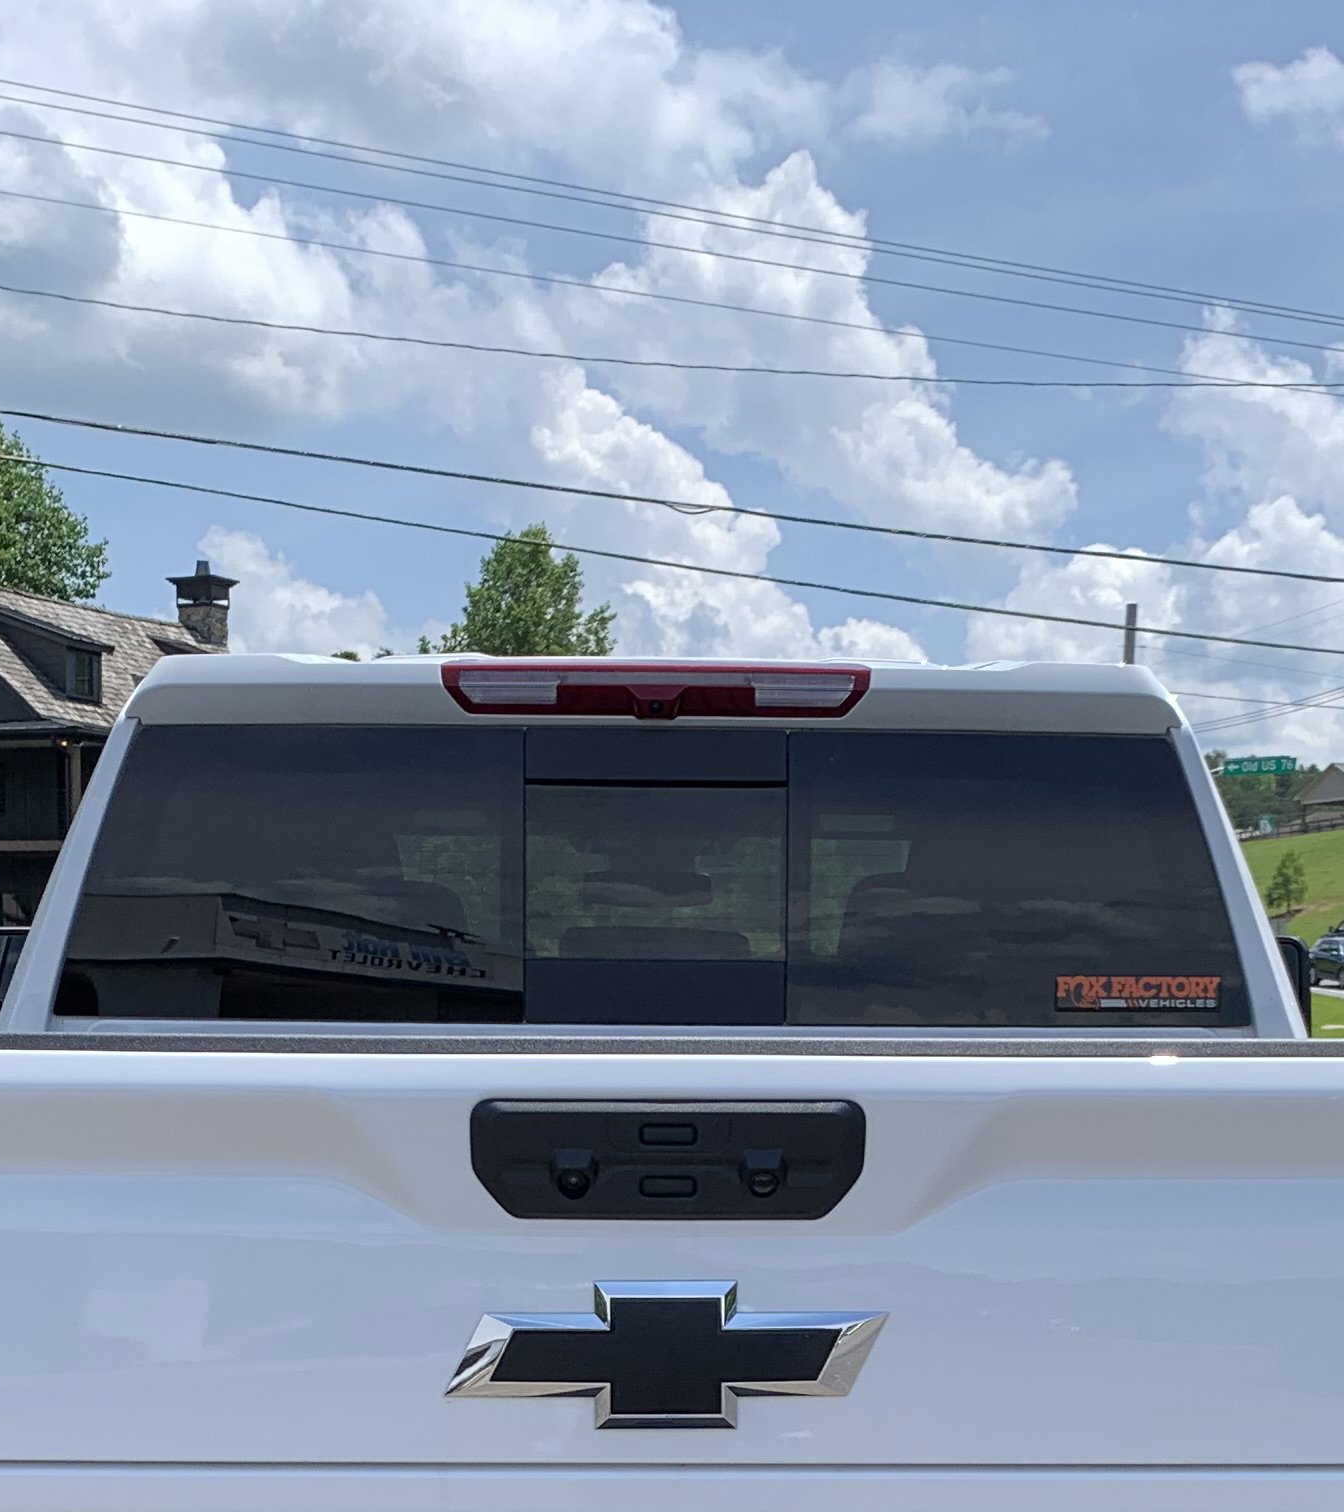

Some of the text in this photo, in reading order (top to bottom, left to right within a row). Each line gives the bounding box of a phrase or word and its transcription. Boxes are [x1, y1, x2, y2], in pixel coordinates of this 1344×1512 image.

[1241, 759, 1294, 773] Old US 76
[1056, 975, 1222, 1004] FOX FACTORY
[1138, 998, 1217, 1009] VEHICLES
